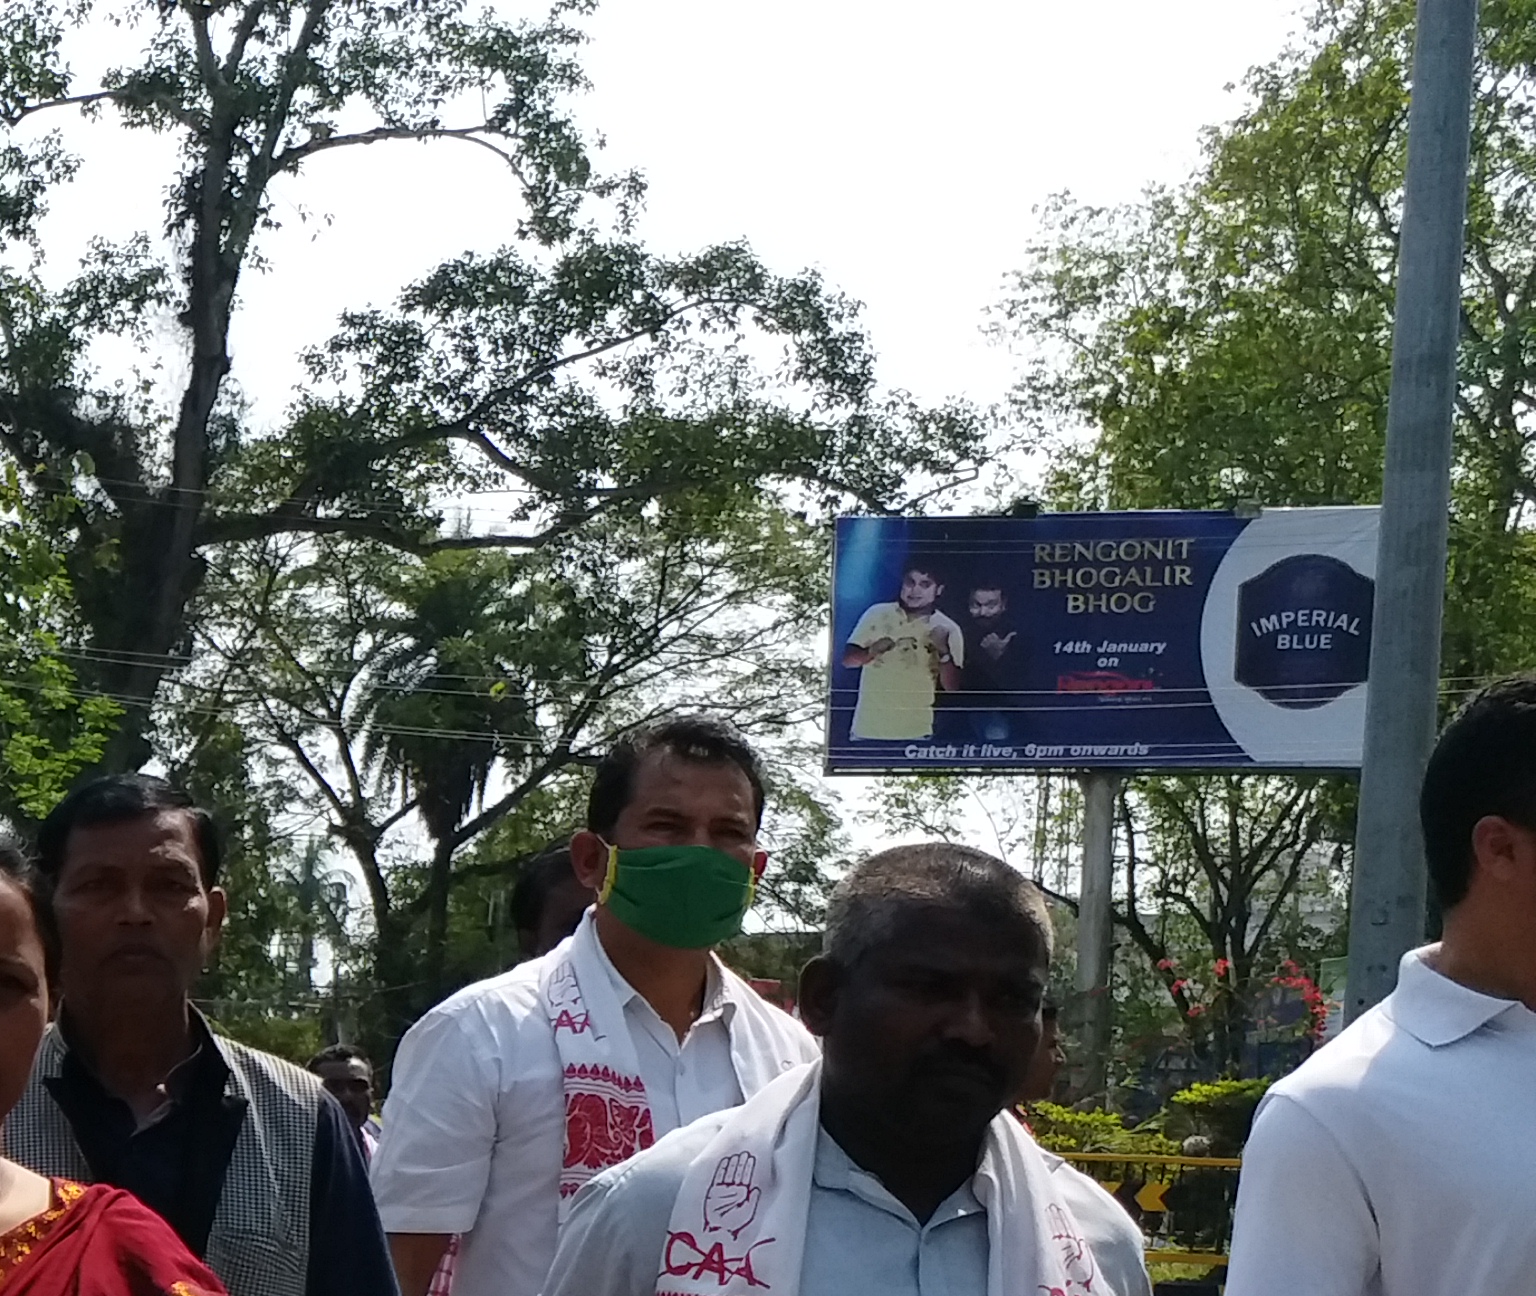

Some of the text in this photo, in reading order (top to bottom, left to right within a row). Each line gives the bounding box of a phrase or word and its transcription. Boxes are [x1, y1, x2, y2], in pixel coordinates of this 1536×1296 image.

[1033, 538, 1196, 563] RENGONIT
[1032, 565, 1194, 589] BHOGALIR
[1067, 592, 1157, 615] BHOG
[1250, 609, 1361, 637] IMPERIAL
[1053, 640, 1167, 655] 14th January
[1276, 633, 1333, 650] BLUE
[1097, 656, 1120, 668] on
[904, 742, 1149, 761] Catch it live, 6pm onwards
